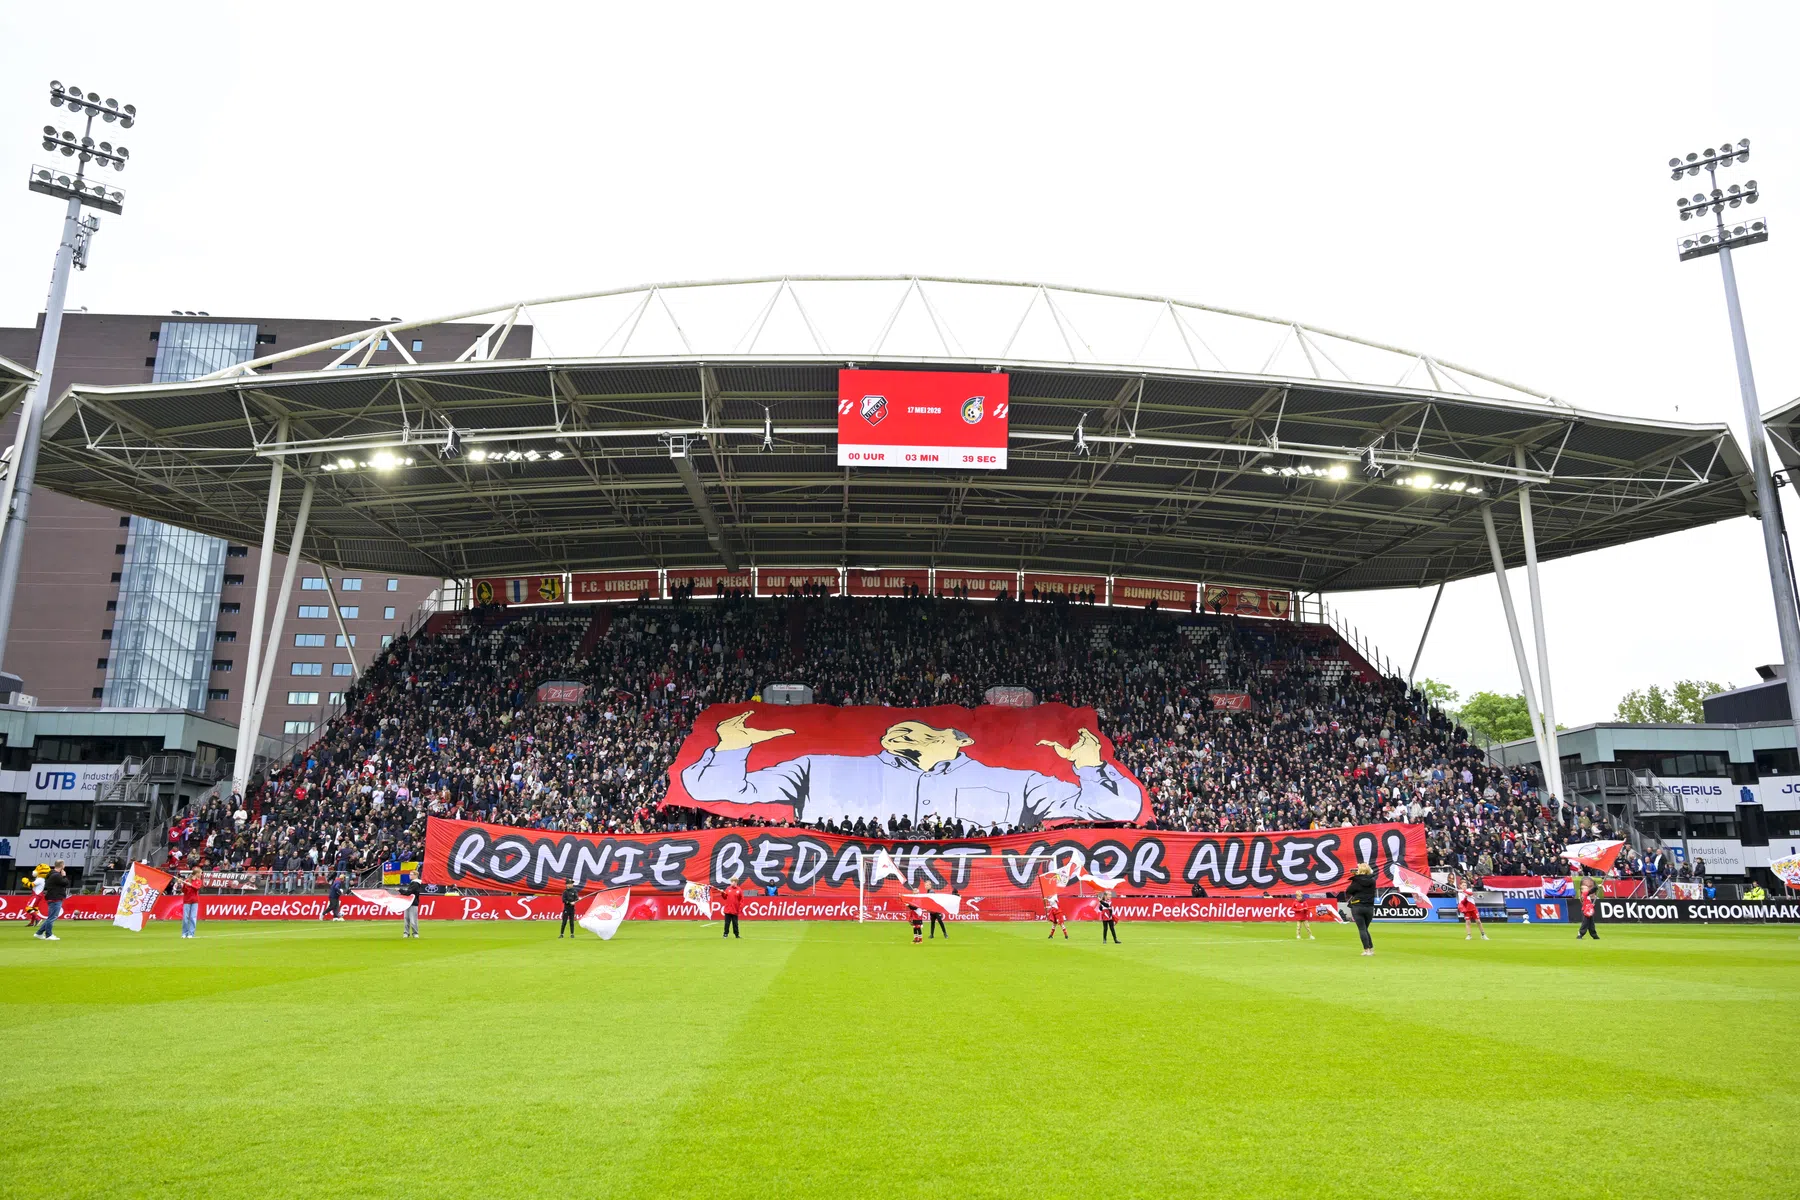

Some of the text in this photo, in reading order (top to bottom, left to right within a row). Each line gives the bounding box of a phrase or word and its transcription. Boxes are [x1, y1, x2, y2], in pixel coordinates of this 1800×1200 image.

[907, 406, 914, 414] 17
[914, 406, 927, 414] MEI
[848, 452, 997, 464] 00 UUR 03 MIN 39 SEC
[581, 579, 649, 593] F.C. UTRECHT
[669, 576, 749, 588] YOU CAN CHECK
[767, 576, 835, 587] OUT ANY TIME
[861, 576, 880, 588] YOU
[943, 578, 1009, 591] BUT YOU CAN
[35, 772, 77, 790] UTB
[1691, 846, 1727, 855] Industrial
[453, 834, 694, 886] RONNIE
[715, 839, 987, 886] BEDANKT
[1007, 842, 1166, 884] VOOR
[1187, 839, 1339, 885] ALLES
[1693, 856, 1739, 866] Aquisitions
[212, 872, 239, 880] MEMORY
[460, 897, 500, 920] Peek
[1688, 904, 1800, 919] SCHOONMAAK
[948, 912, 979, 921] Utrecht
